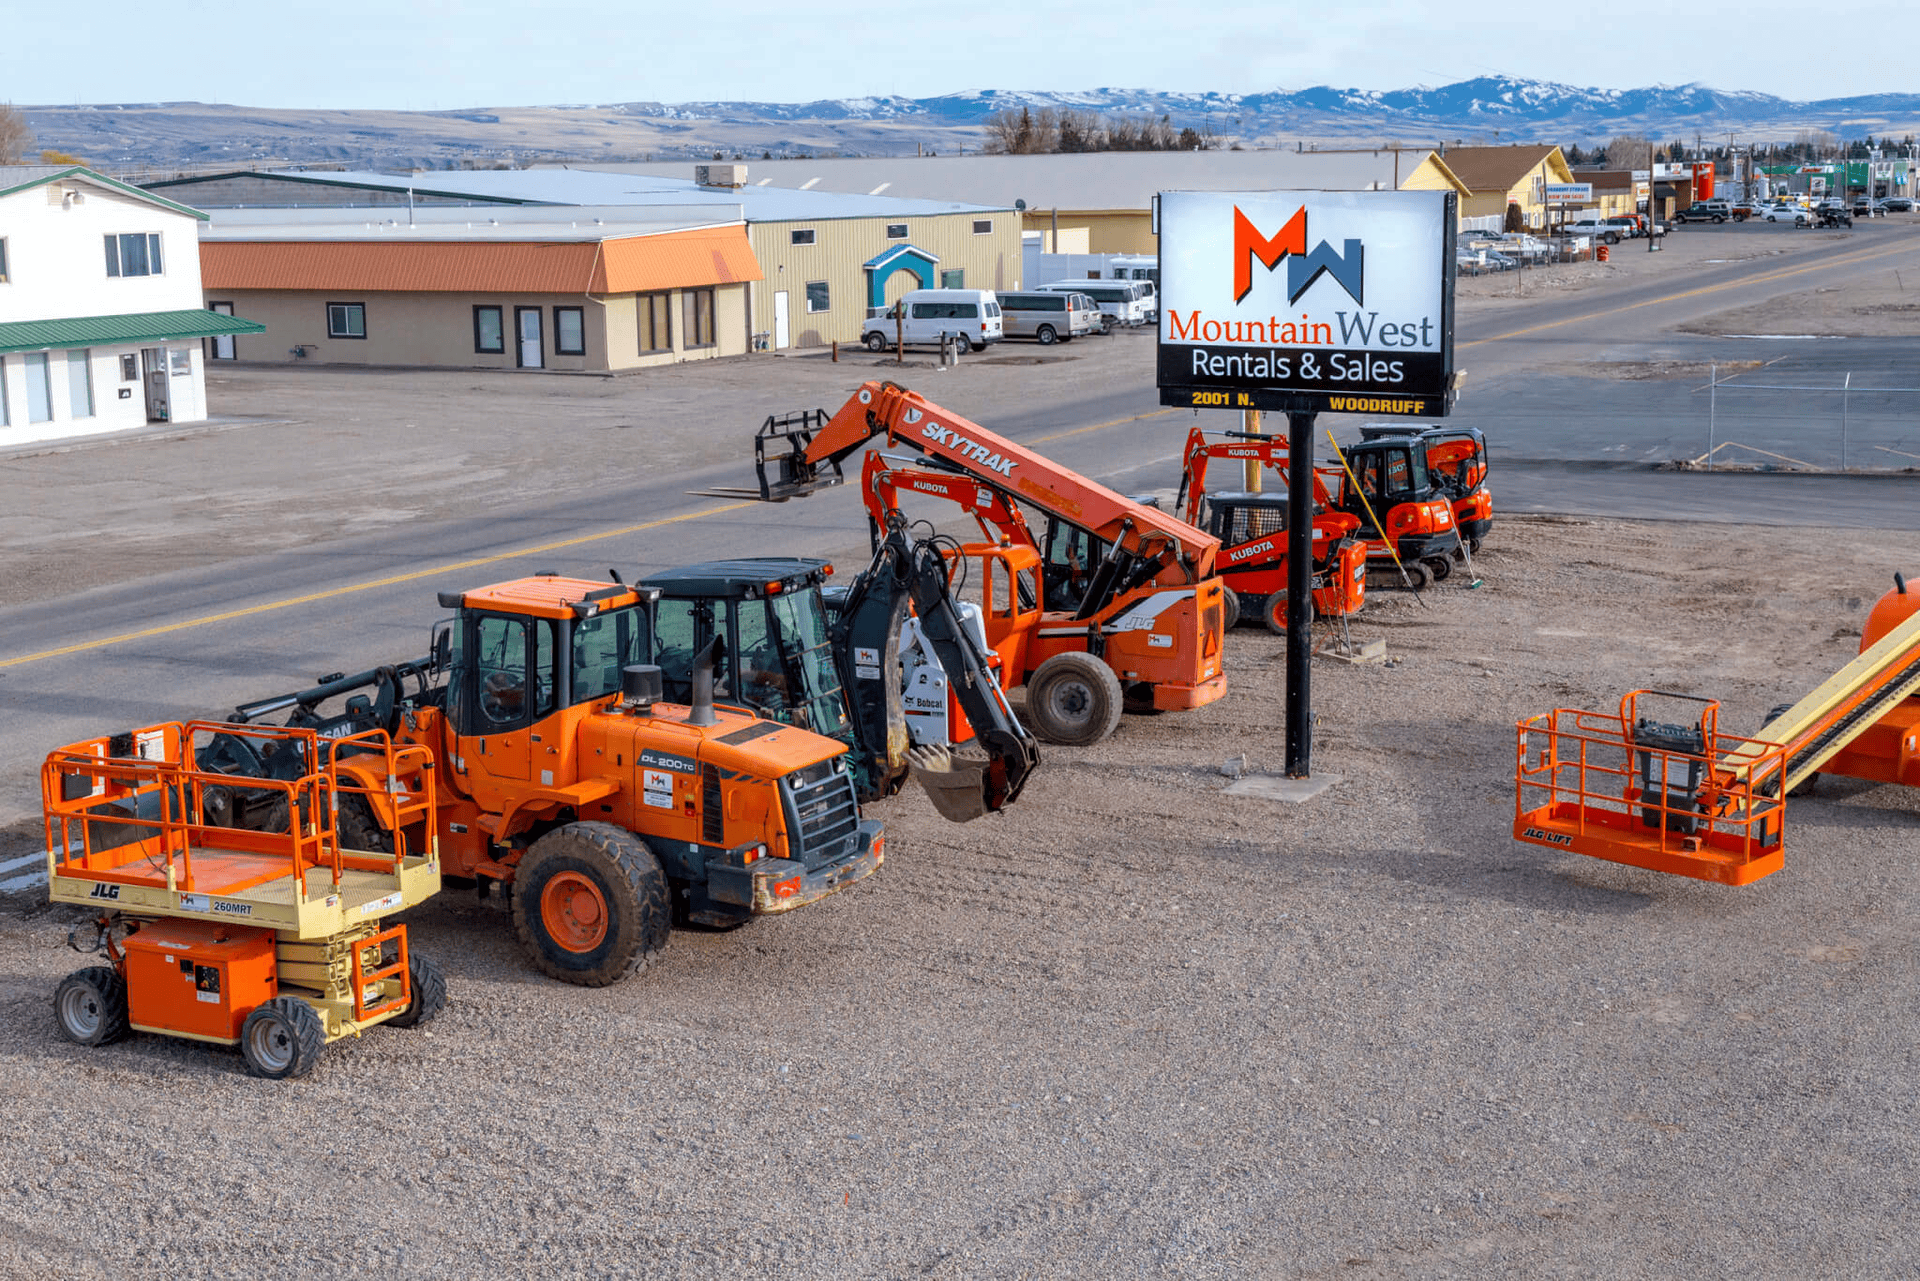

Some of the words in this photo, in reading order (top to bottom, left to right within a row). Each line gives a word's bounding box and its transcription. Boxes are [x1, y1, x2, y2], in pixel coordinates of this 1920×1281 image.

[1192, 349, 1291, 379] Rentals
[1299, 352, 1322, 380] &
[1329, 352, 1404, 383] Sales
[1192, 392, 1230, 406] 2001
[1237, 393, 1255, 407] N.
[1329, 396, 1425, 414] WOODRUFF
[921, 421, 1019, 478] SKYTRAK
[1228, 449, 1260, 457] KUBOTA
[913, 480, 948, 494] KUBOTA
[1229, 540, 1275, 562] KUBOTA
[916, 698, 943, 709] Bobcat
[296, 722, 352, 754] DSAN
[641, 755, 657, 763] DL
[1523, 828, 1545, 839] JLG
[1546, 832, 1573, 845] LIFT
[90, 883, 120, 900] JLG
[213, 901, 253, 915] 260MRT
